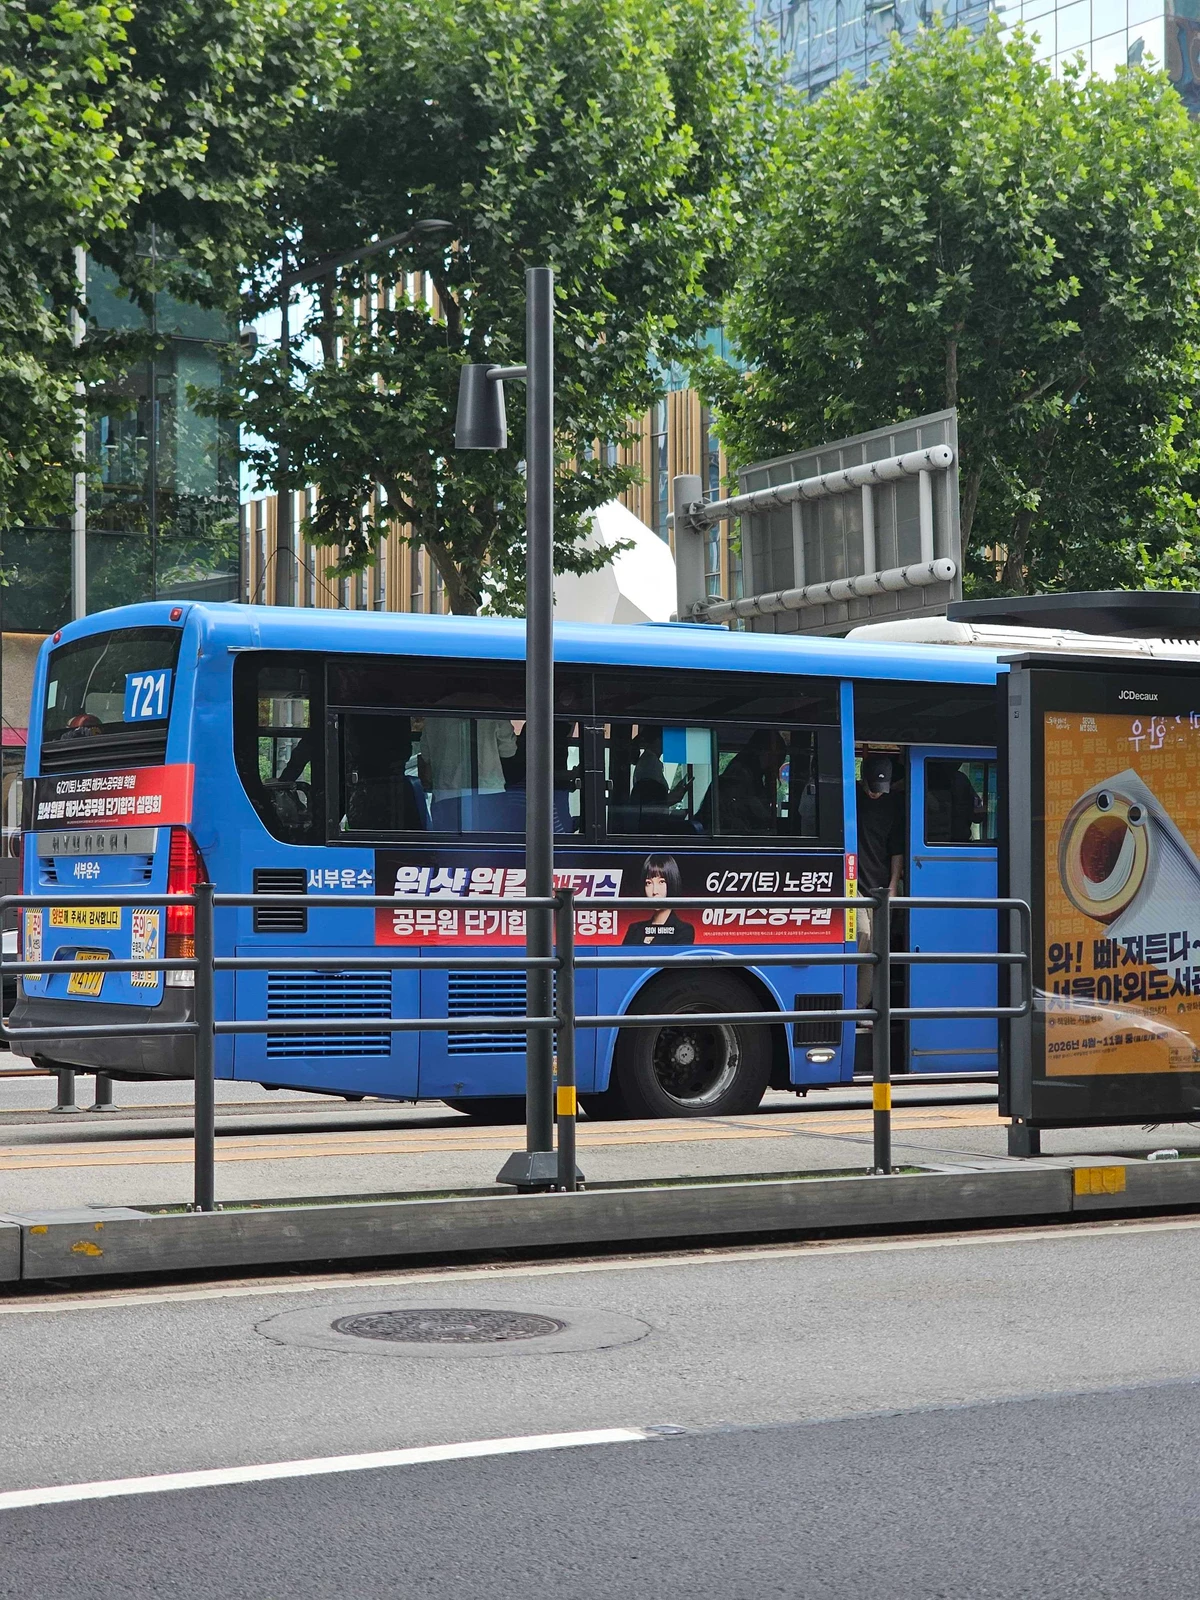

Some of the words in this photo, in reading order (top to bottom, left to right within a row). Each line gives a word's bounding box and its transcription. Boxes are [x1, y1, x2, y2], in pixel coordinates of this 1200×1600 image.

[131, 674, 165, 717] 721
[1118, 690, 1158, 701] JCDecaux
[65, 798, 105, 818] 해커스공무원
[106, 796, 135, 816] 단기합격
[136, 795, 162, 814] 설명회
[52, 833, 128, 853] HYUNDAI
[73, 861, 100, 880] 서부운수
[307, 869, 373, 889] 서부운수
[706, 871, 780, 893] 6/27(토)
[783, 871, 833, 892] 노량진
[71, 911, 87, 924] 주셔서
[89, 912, 118, 925] 감사합니다
[132, 915, 145, 938] 주의
[392, 909, 458, 936] 공무원
[574, 910, 618, 936] 명회
[1047, 941, 1083, 975] 와!
[1048, 1042, 1079, 1053] 2026년
